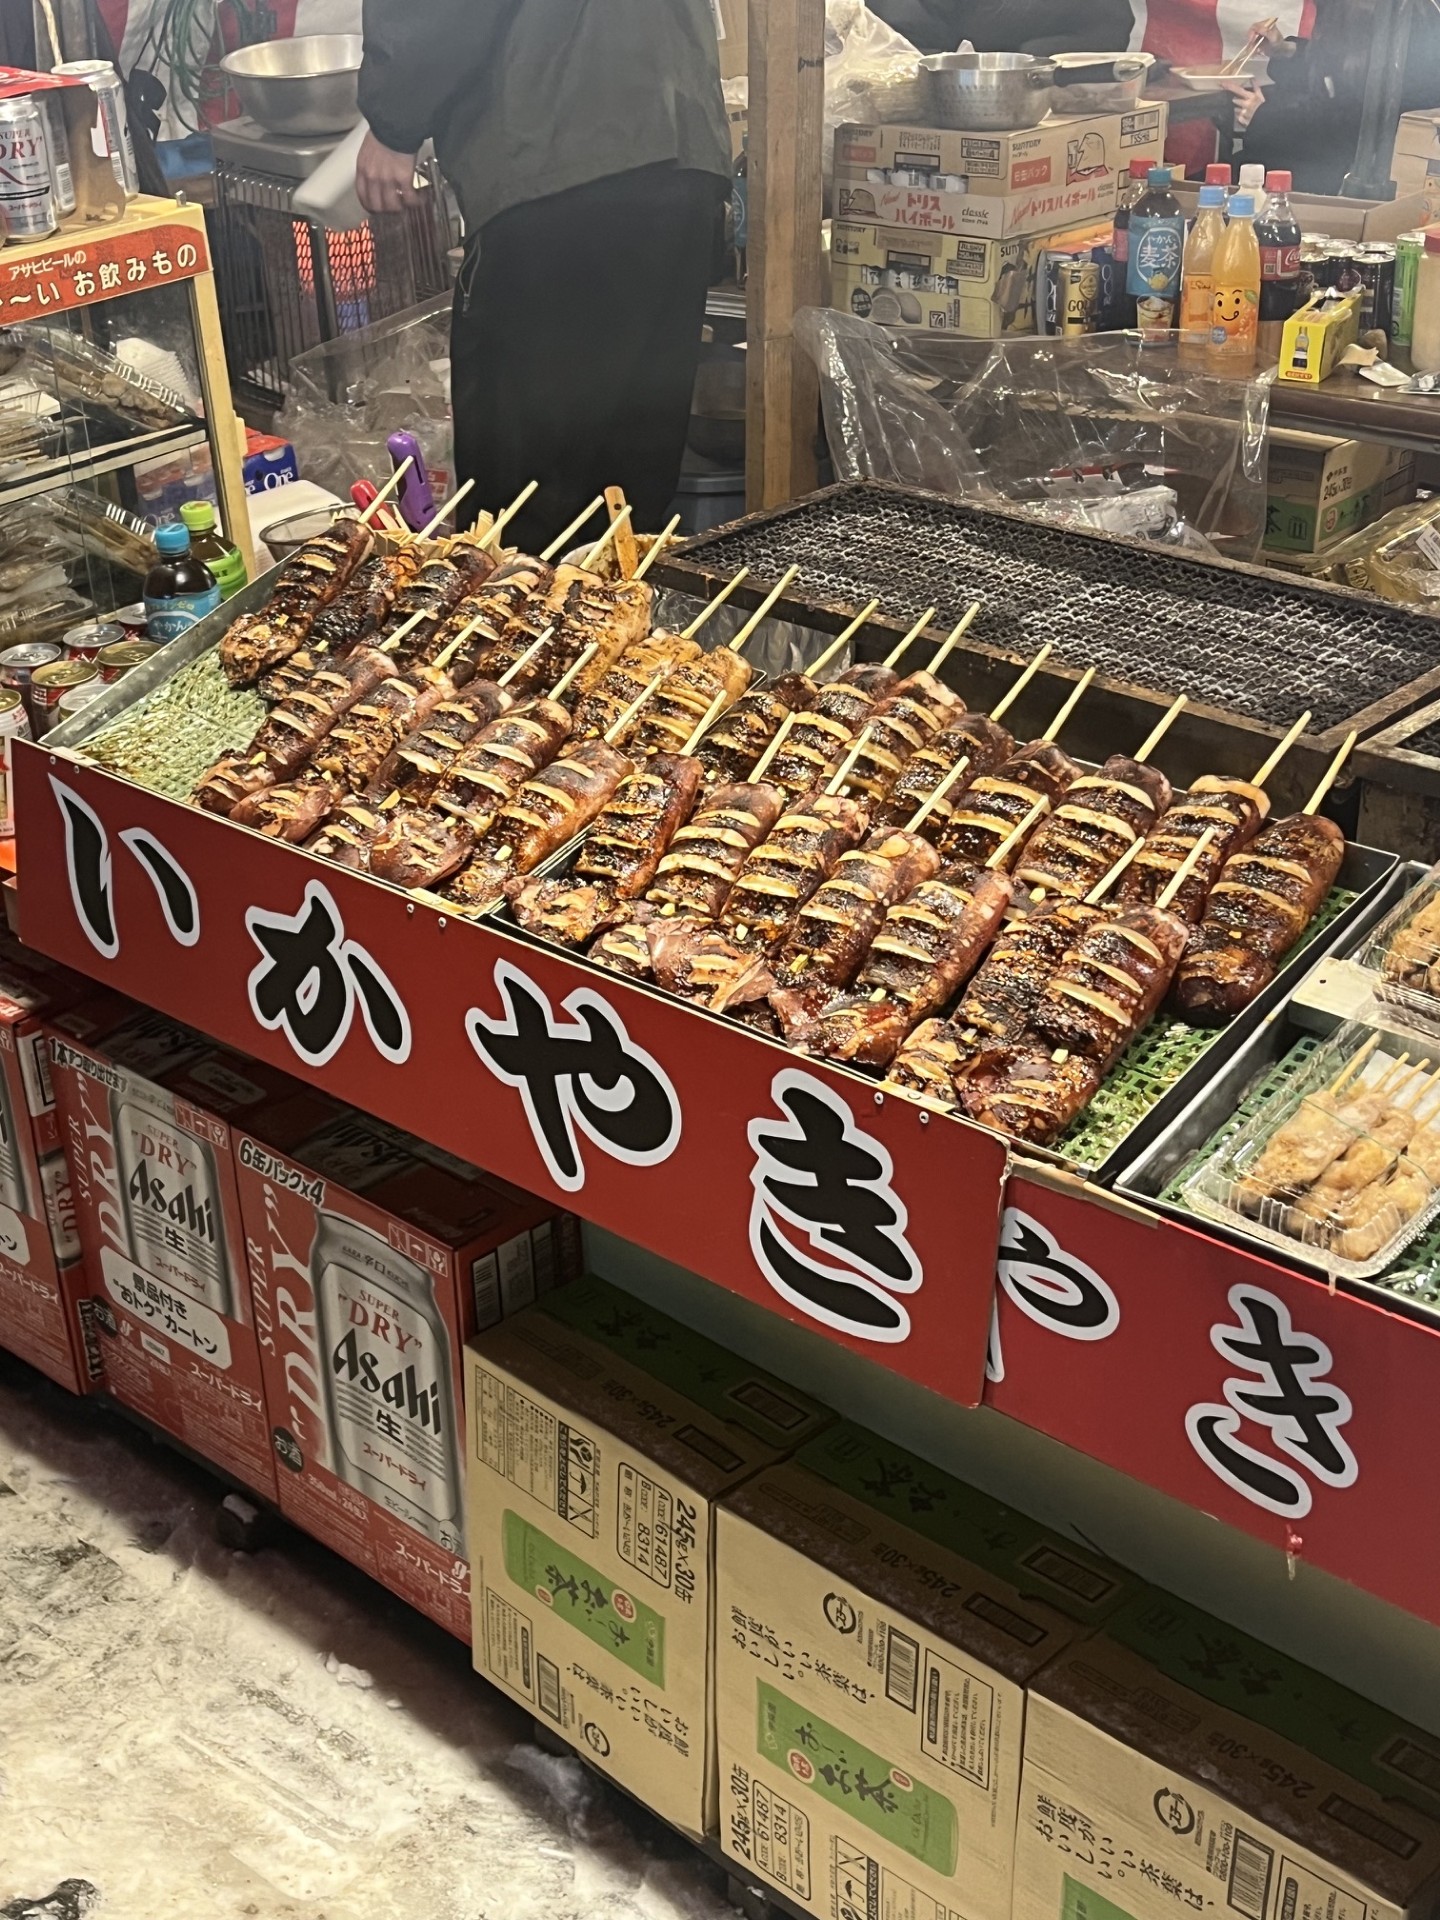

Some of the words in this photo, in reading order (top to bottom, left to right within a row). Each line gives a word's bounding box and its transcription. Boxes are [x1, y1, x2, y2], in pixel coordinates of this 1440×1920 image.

[895, 208, 955, 230] ハイボール
[907, 193, 941, 210] トリス
[8, 251, 87, 280] アサヒビールの
[74, 243, 197, 297] お飲みもの
[1142, 245, 1180, 267] 麦茶
[263, 472, 294, 490] One
[48, 773, 922, 1343] いかやき
[69, 1115, 92, 1206] SUPER
[148, 1124, 179, 1148] SUPER
[129, 1159, 216, 1243] Asahi
[165, 1227, 188, 1256] 生
[364, 1255, 386, 1275] 辛口
[132, 1272, 188, 1320] 景品付き
[247, 1237, 276, 1357] SUPER
[359, 1289, 400, 1321] SUPER
[190, 1362, 262, 1412] スーパードライ
[333, 1328, 441, 1435] Asahi
[275, 1434, 303, 1467] お酒
[376, 1409, 405, 1446] 生
[363, 1441, 426, 1492] スーパードライ
[637, 1520, 649, 1568] 8314
[654, 1521, 667, 1581] 61487
[544, 1564, 609, 1610] お茶
[732, 1629, 803, 1680] おいしい。
[732, 1606, 875, 1704] 鮮度がいい茶葉は、
[730, 1761, 749, 1860] 245g×30缶
[819, 1763, 898, 1814] お茶
[756, 1788, 769, 1842] 61487
[774, 1802, 787, 1846] 8314
[1036, 1820, 1124, 1879] おいしい。
[1037, 1795, 1214, 1911] 鮮度がいい茶葉は、
